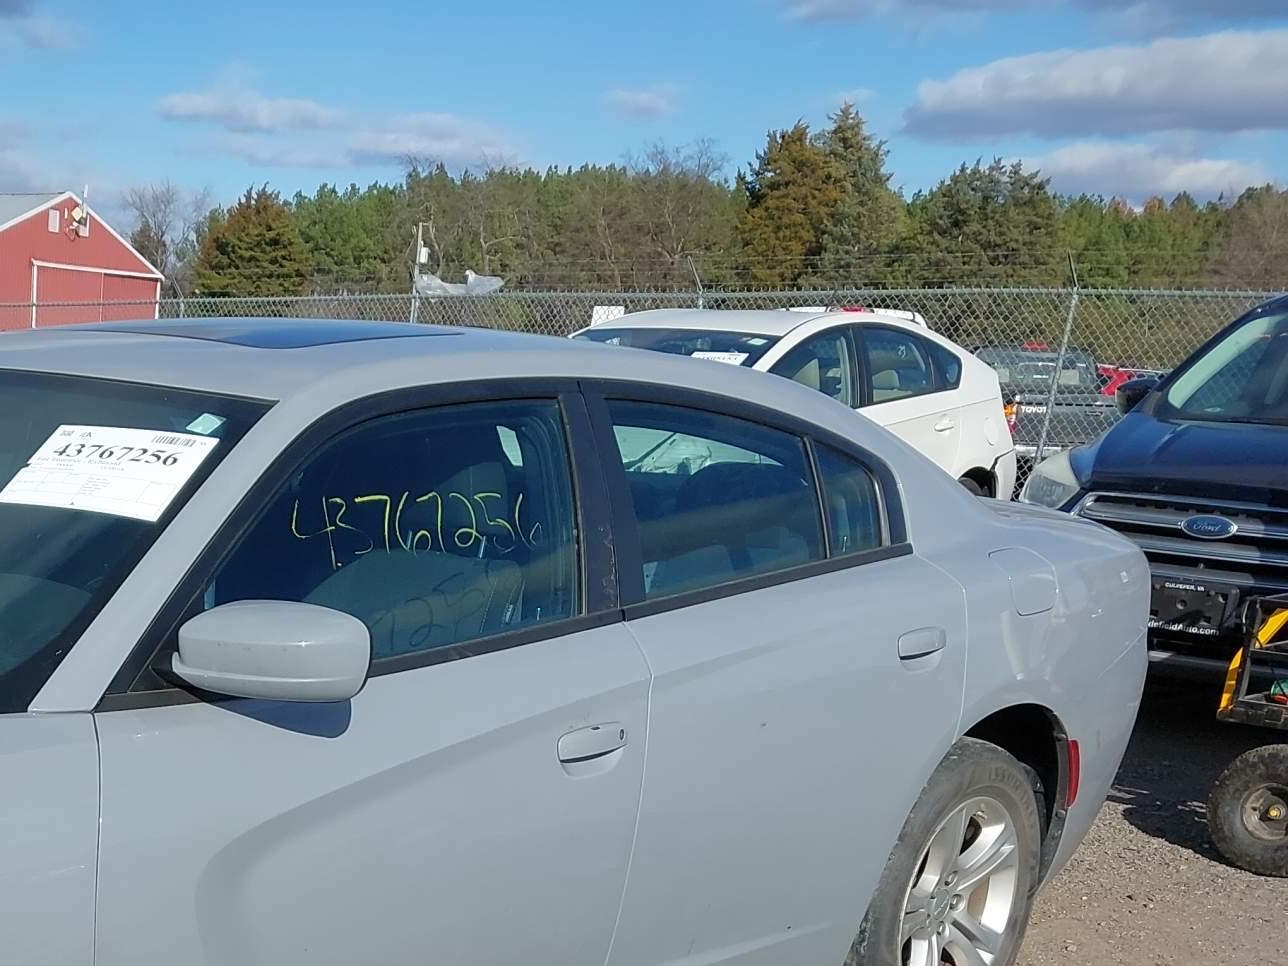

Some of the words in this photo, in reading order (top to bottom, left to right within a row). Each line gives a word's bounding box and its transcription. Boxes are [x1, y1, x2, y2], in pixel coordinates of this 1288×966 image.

[1021, 405, 1048, 413] TOYOT
[53, 443, 184, 467] 43767256
[292, 490, 542, 570] 43767256
